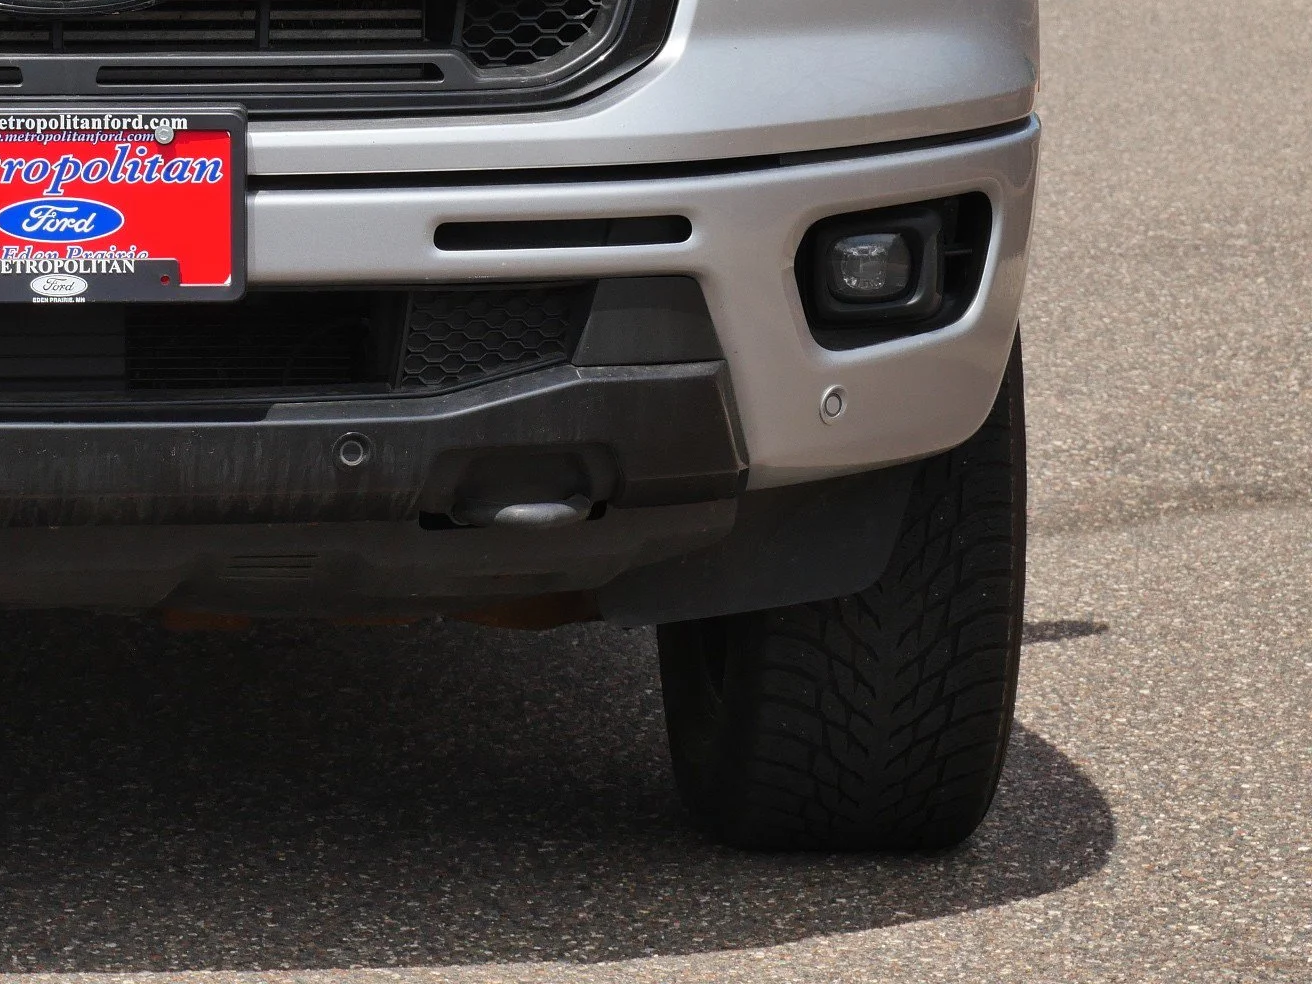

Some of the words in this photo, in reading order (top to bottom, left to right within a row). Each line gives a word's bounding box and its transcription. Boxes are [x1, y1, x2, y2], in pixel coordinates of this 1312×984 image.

[22, 204, 96, 233] Ford
[2, 245, 59, 259] Eden
[65, 245, 149, 259] Prairie
[42, 277, 75, 292] Ford
